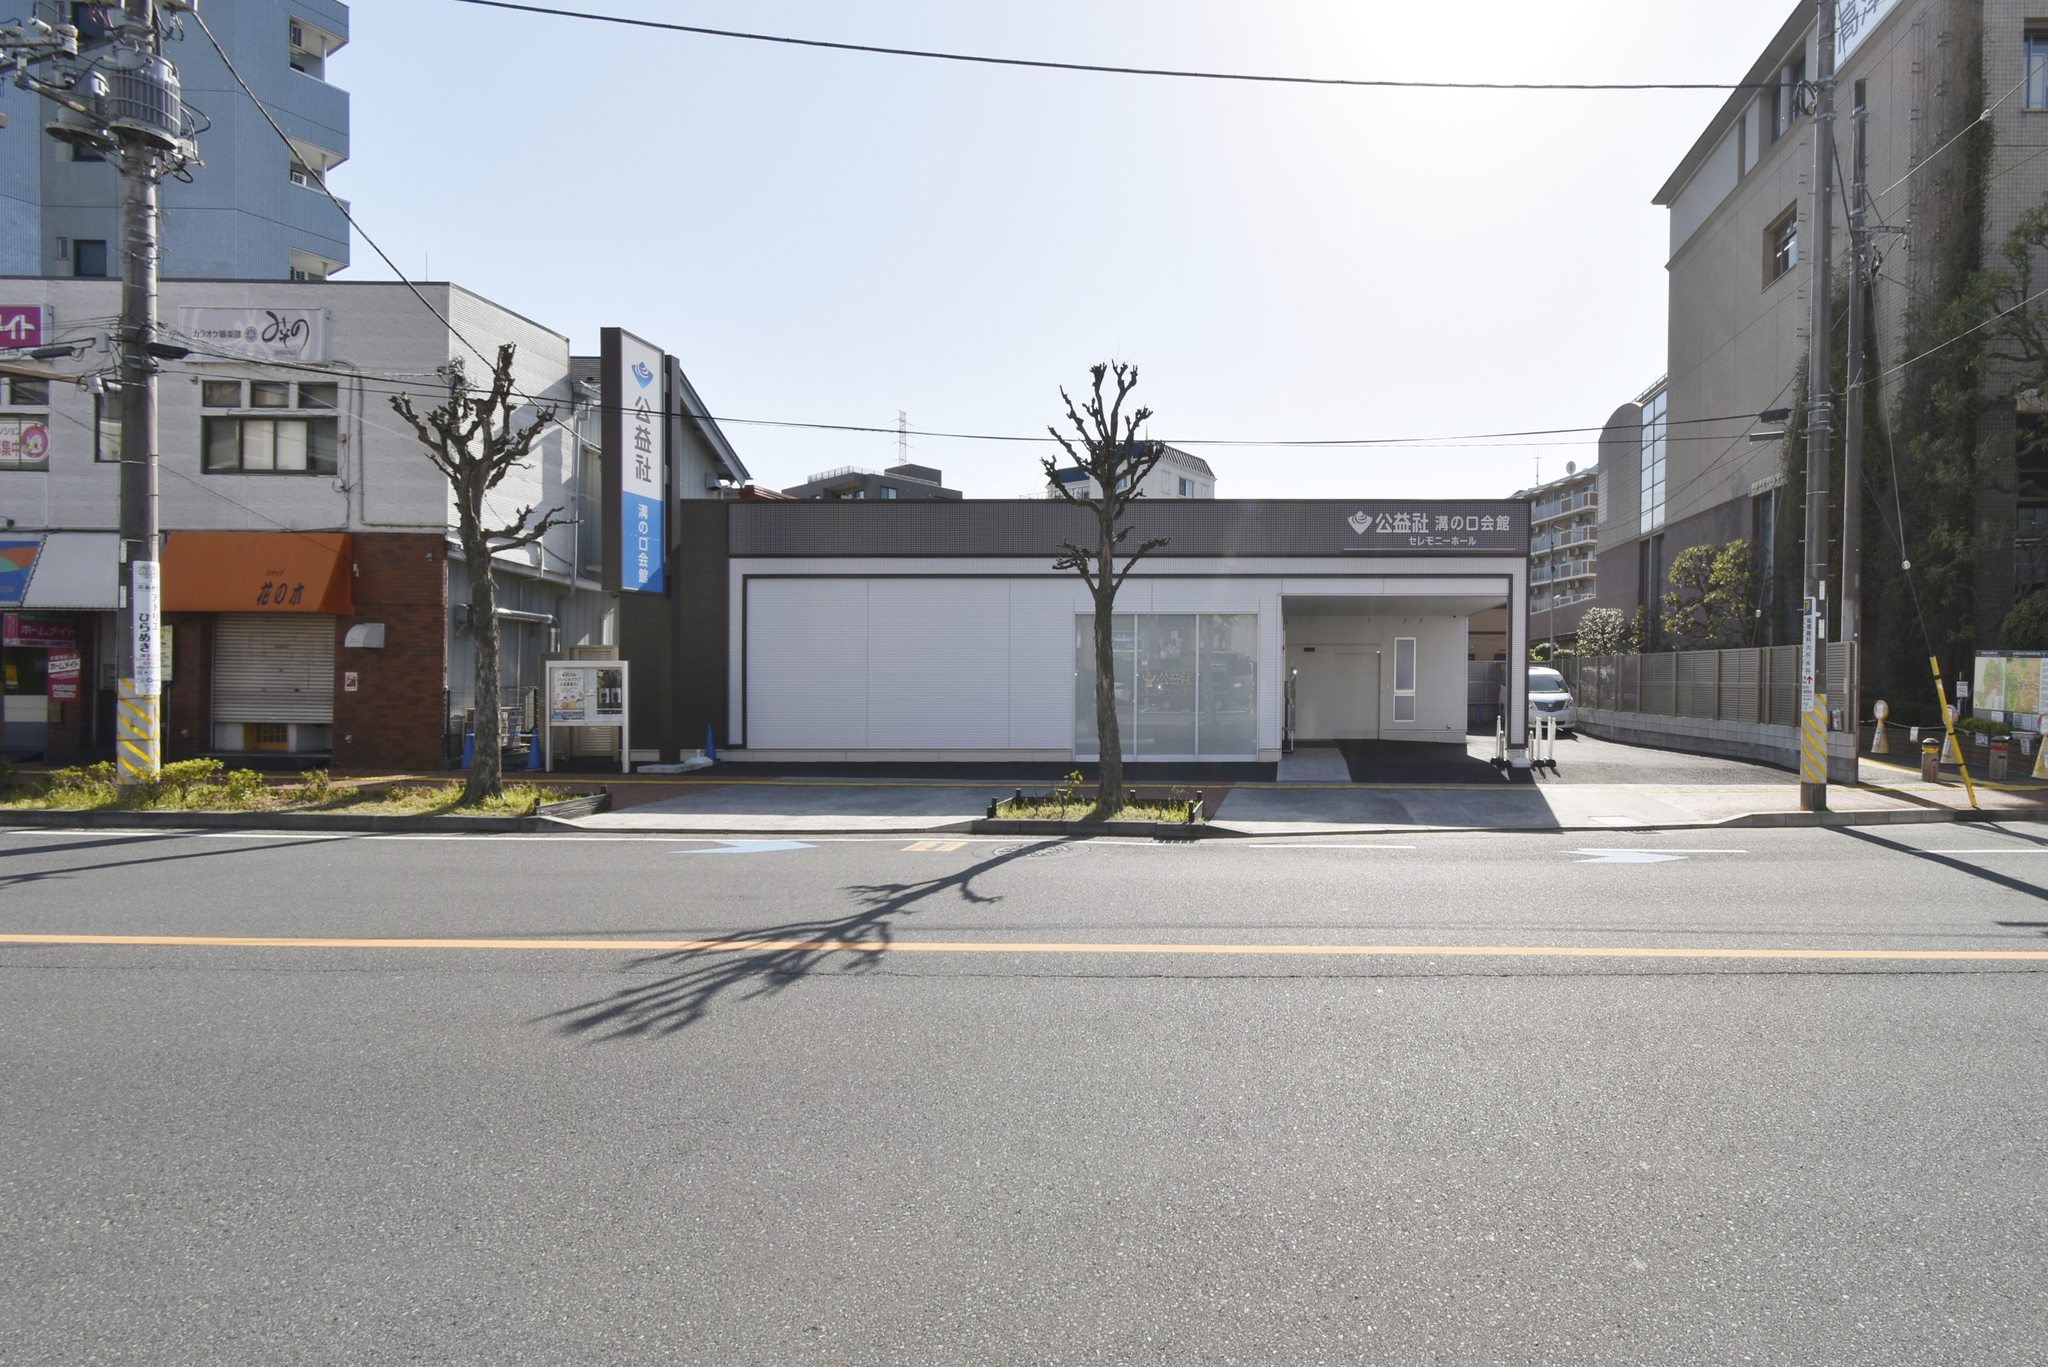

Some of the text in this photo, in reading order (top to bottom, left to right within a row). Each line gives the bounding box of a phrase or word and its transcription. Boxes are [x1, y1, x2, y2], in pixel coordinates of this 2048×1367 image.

[0, 440, 21, 457] 集中
[634, 395, 652, 484] 公益社
[1375, 512, 1510, 533] 公益社 溝の口会館
[638, 503, 649, 584] 溝の口会館
[1408, 536, 1477, 546] セレモニーホール
[151, 593, 159, 631] アトリエ
[20, 624, 76, 636] ホームメイト
[139, 613, 150, 653] ひらめき
[1159, 672, 1191, 685] 公益社
